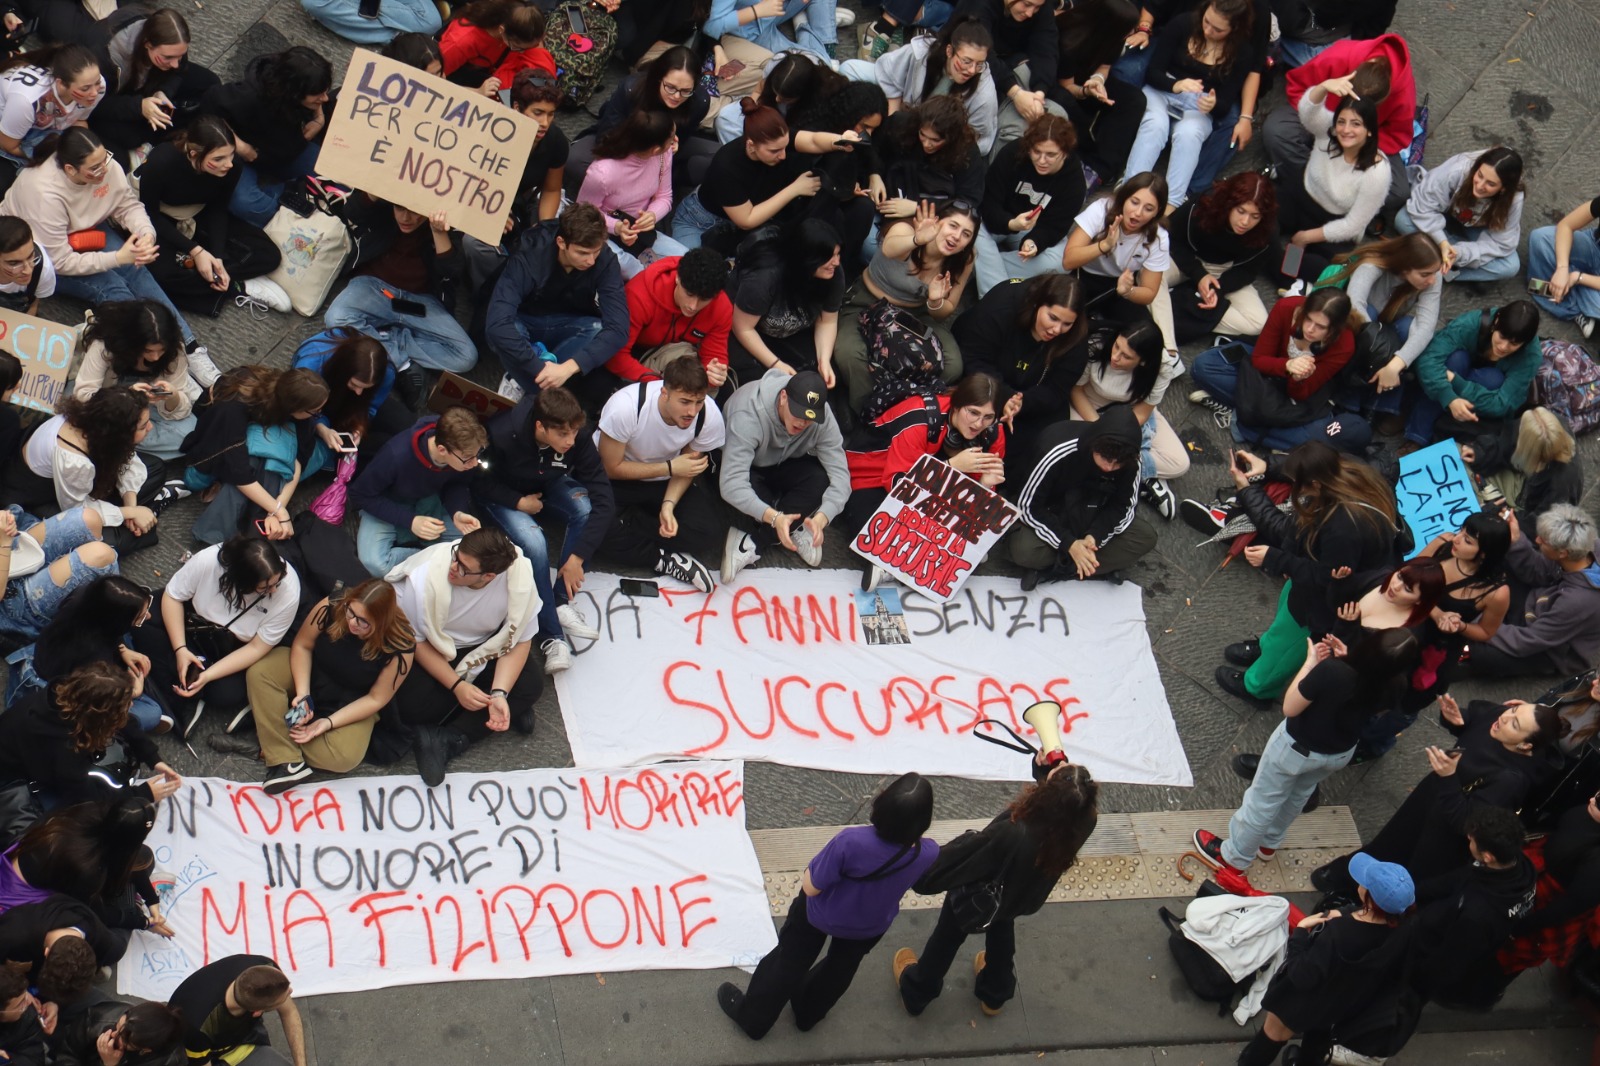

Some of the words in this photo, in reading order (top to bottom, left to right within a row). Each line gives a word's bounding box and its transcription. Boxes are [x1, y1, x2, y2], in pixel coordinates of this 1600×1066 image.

[356, 61, 517, 143] LOTTIAMO
[350, 95, 401, 134] PER
[468, 144, 511, 176] CHE
[370, 136, 393, 164] È
[398, 147, 505, 214] NOSTRO
[18, 370, 65, 405] ILIPPONE
[442, 379, 512, 413] DA
[856, 511, 973, 598] SUCCURSALE
[948, 531, 967, 557] LA
[659, 585, 718, 645] 7
[900, 587, 1070, 638] SENZA
[358, 784, 455, 832] NON
